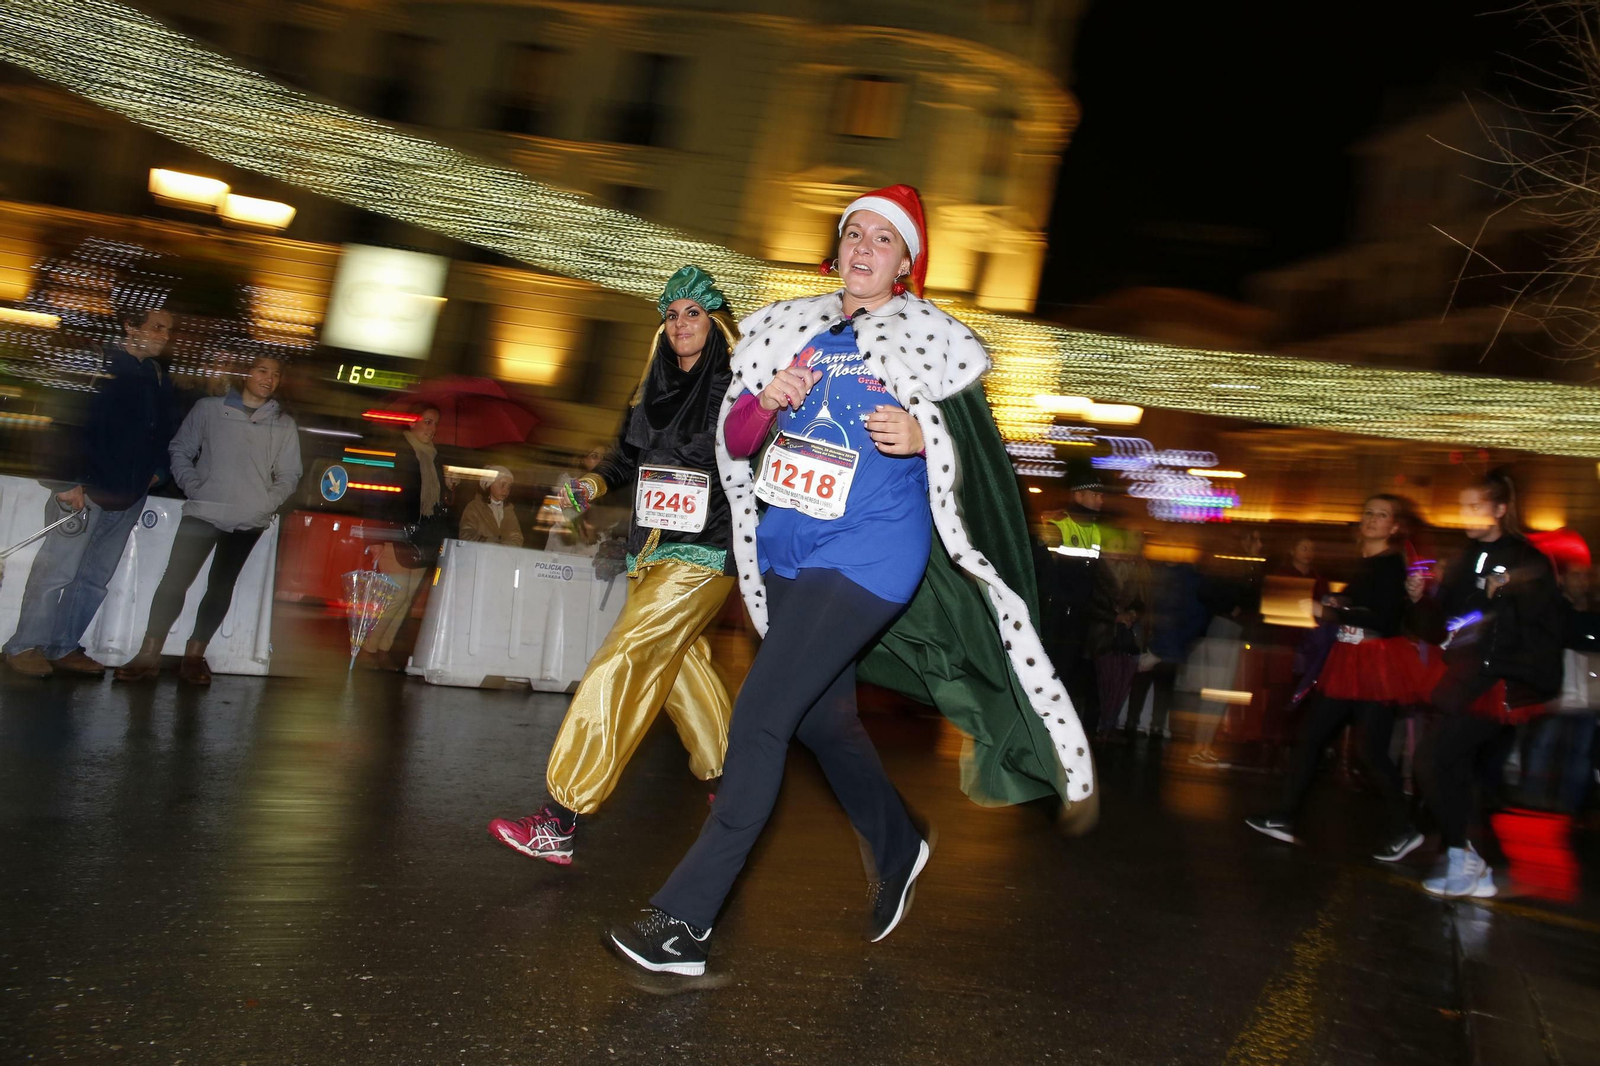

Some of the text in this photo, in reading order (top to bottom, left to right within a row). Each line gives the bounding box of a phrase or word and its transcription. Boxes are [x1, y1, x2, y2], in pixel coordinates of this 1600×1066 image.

[806, 348, 863, 368] Carrer
[827, 363, 872, 378] Noctu
[858, 377, 882, 386] Gran
[866, 384, 887, 394] 2019
[771, 459, 836, 499] 1218
[644, 490, 696, 514] 1246
